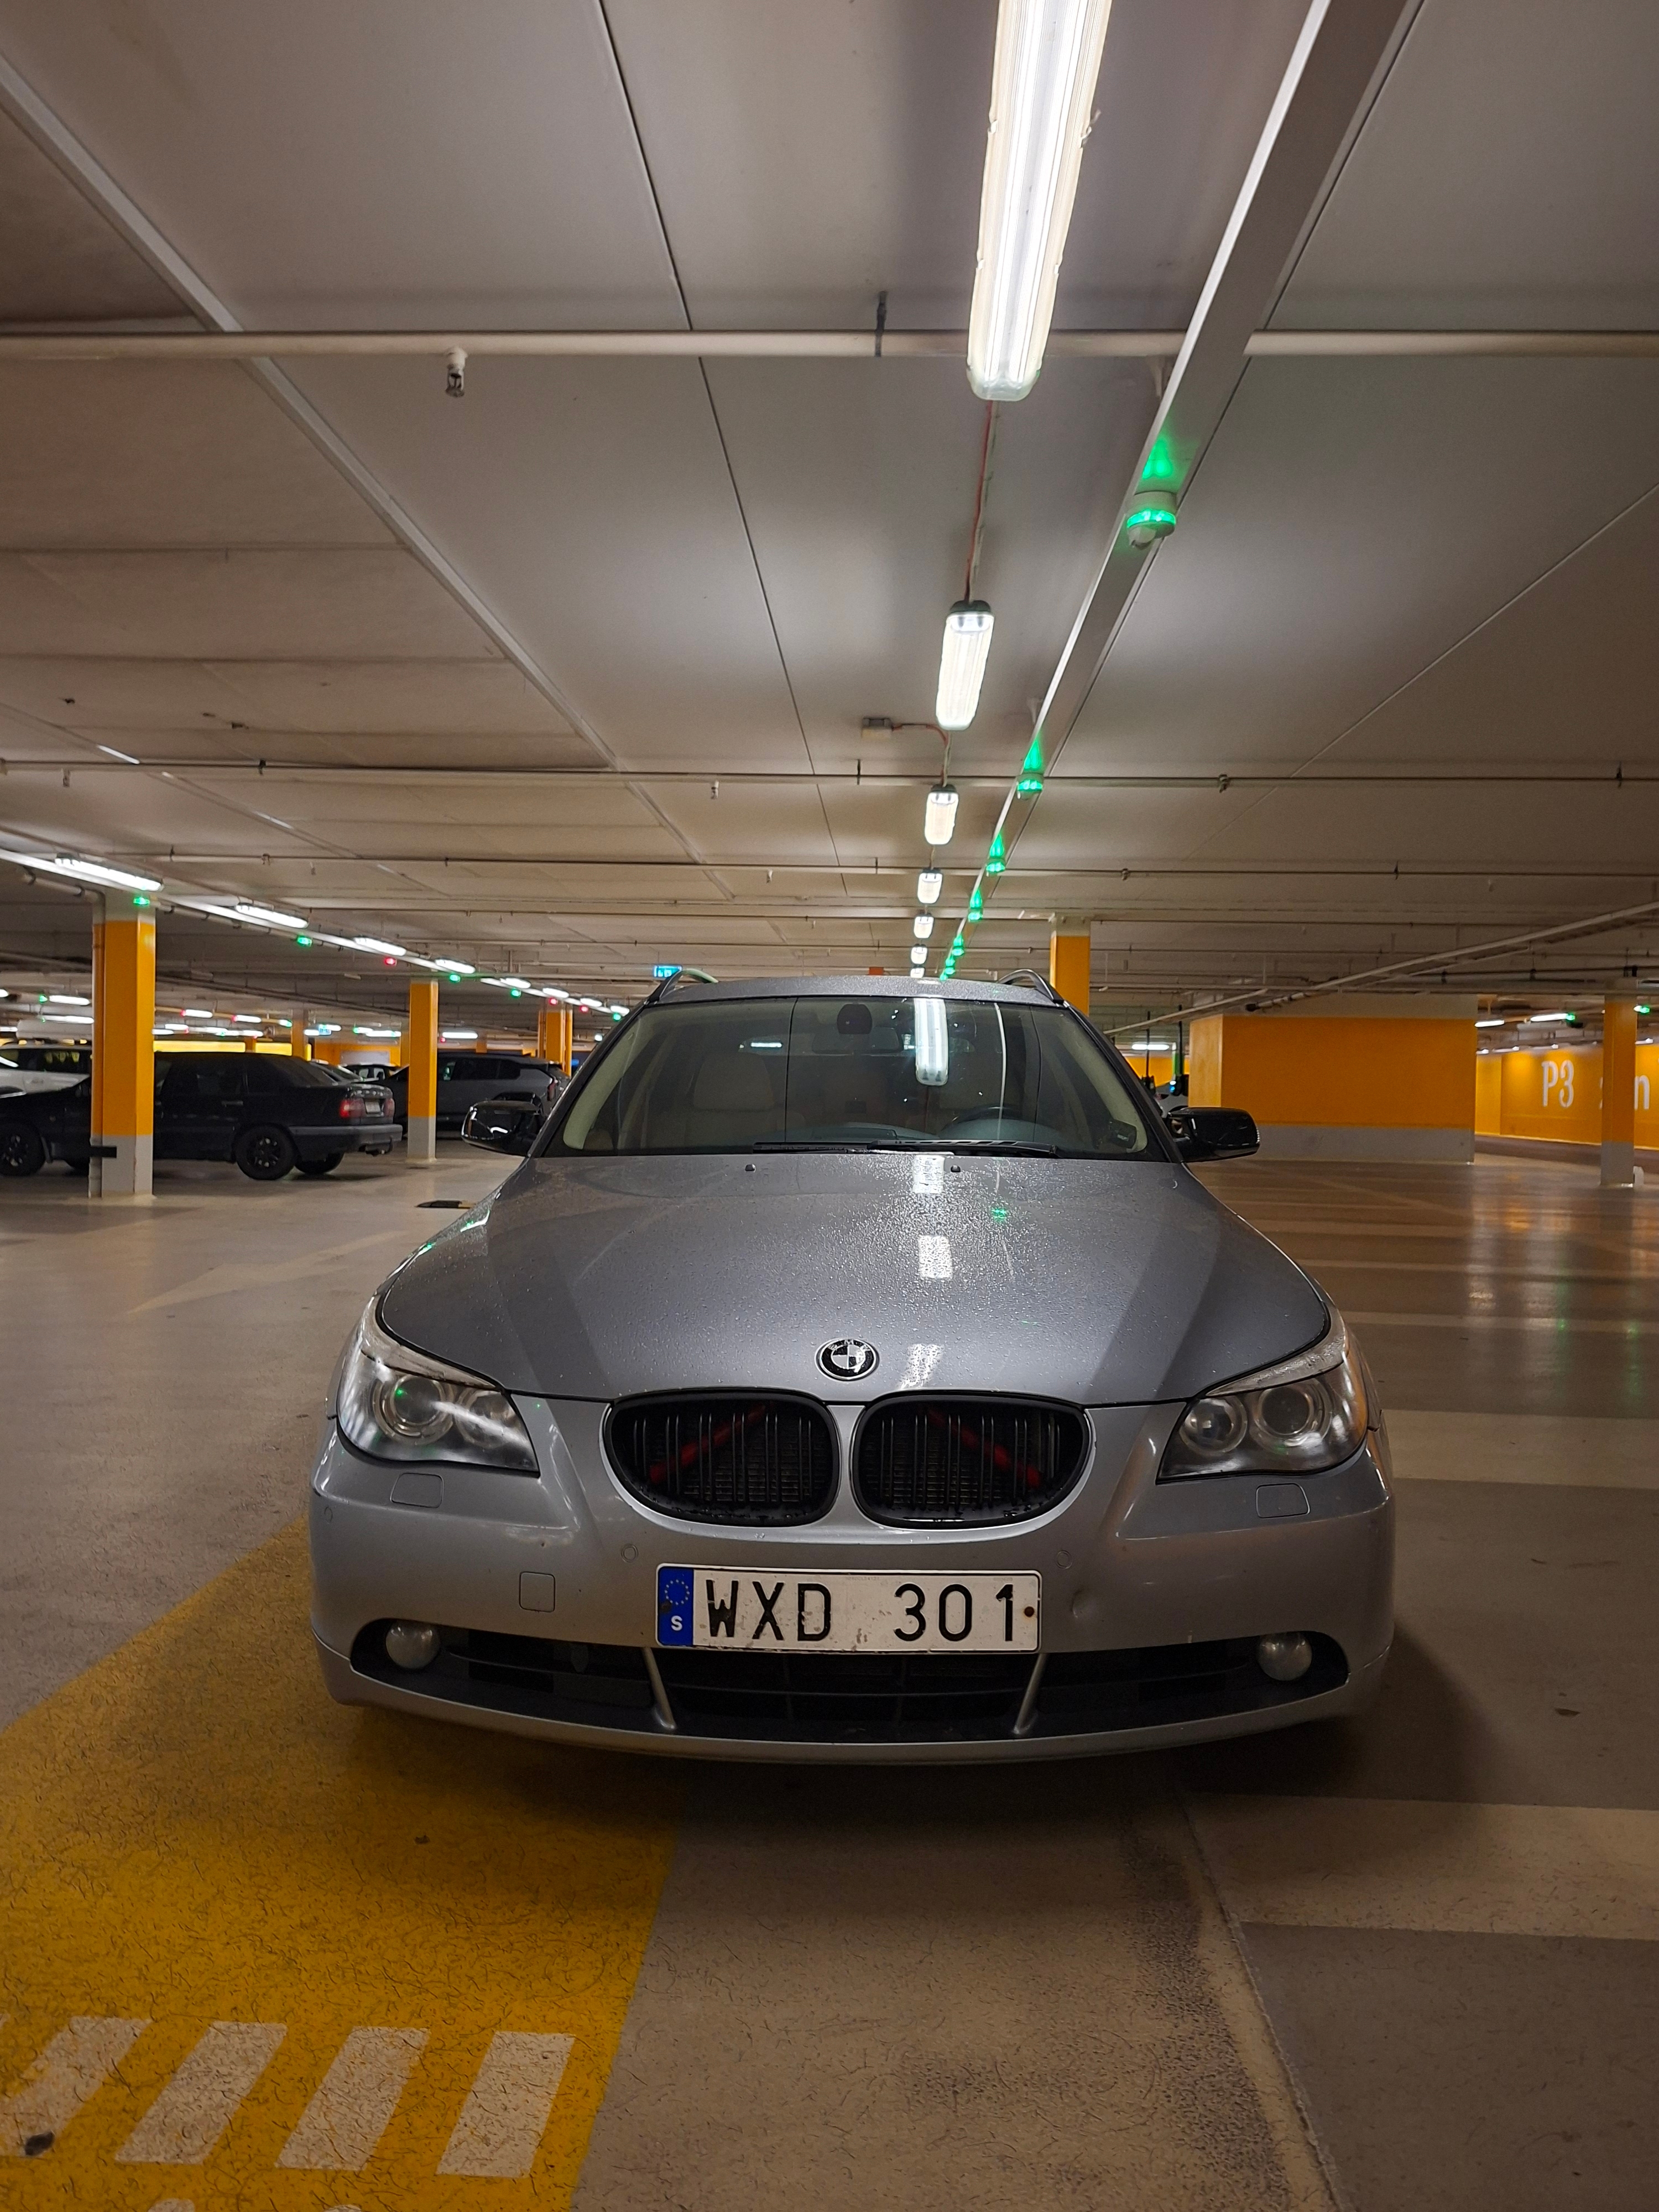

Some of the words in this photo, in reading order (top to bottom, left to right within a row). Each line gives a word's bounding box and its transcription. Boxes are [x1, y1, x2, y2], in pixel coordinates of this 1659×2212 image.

[1541, 1060, 1574, 1108] P3
[671, 1615, 683, 1631] S
[706, 1579, 831, 1641] WXD
[894, 1583, 1013, 1641] 301
